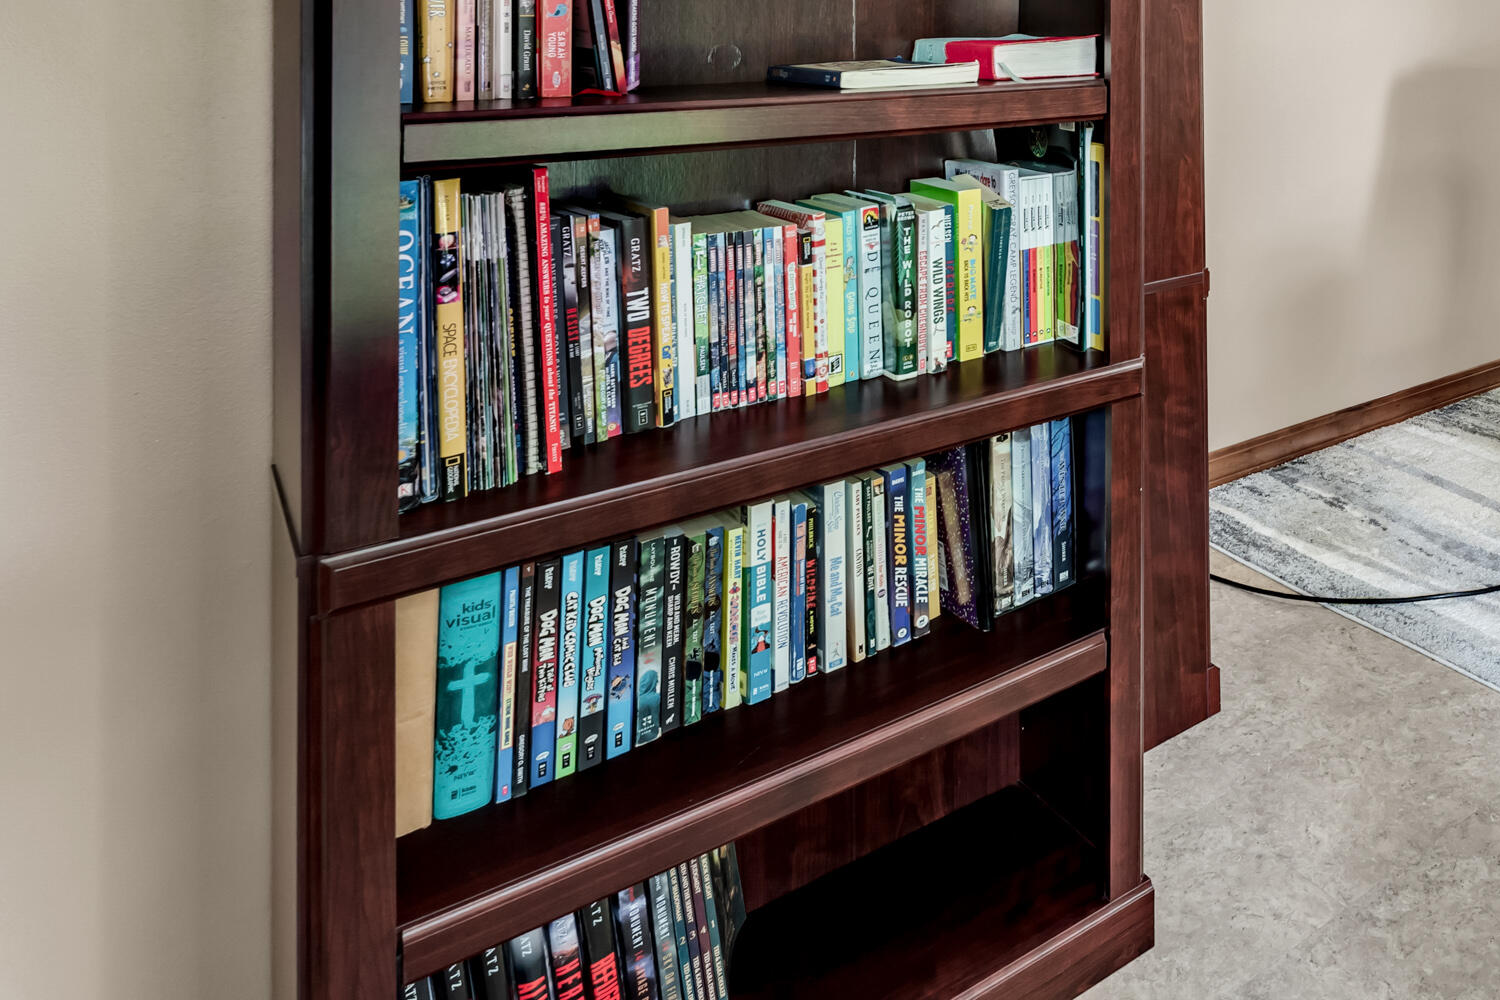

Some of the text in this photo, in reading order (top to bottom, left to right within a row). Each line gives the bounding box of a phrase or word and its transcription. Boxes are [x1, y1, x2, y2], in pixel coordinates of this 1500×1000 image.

[522, 29, 531, 71] David Grant
[548, 32, 557, 58] YOUNG
[557, 31, 566, 59] SARAH
[539, 222, 550, 257] AMAZING
[562, 226, 572, 257] GRATZ
[631, 237, 642, 274] GRATZ
[399, 229, 416, 336] OCEAN
[541, 258, 552, 295] ANSWERS
[901, 226, 913, 348] THE WILD ROBOT
[932, 257, 945, 324] WILD WINGS
[969, 258, 977, 299] BIG NATE
[1009, 269, 1018, 302] LEGEND
[696, 274, 707, 325] HATCHET
[918, 250, 928, 354] ESCAPE FROM CHERNOBYL
[543, 322, 554, 366] QUESTIONS
[567, 308, 579, 341] RESIST
[626, 287, 653, 389] TWO DEGREES
[866, 287, 882, 362] QUEEN
[442, 322, 458, 442] SPACE ENCYCLOPEDIA
[546, 367, 555, 386] about
[547, 388, 557, 400] the
[548, 401, 558, 433] TITANIC
[669, 546, 681, 585] ROWDY
[733, 534, 742, 579] KEVIN HART
[755, 528, 767, 603] HOLY BIBLE
[893, 495, 908, 608] THE MINOR RESCUE
[913, 487, 928, 603] THE MINOR MIRACLE
[565, 591, 579, 612] CAT
[673, 593, 681, 607] WILD
[776, 556, 789, 649] AMERICAN REVOLUTION
[806, 558, 816, 609] WILDFIRE
[827, 556, 842, 617] Me and My Cat
[445, 609, 496, 628] visual
[523, 598, 531, 626] TREASURE
[586, 595, 607, 647] DOG MAN
[612, 585, 632, 637] DOG MAN
[642, 587, 658, 649] MONUMENT
[666, 594, 675, 648] SHARP AND KEEN
[673, 608, 681, 621] AND
[536, 608, 559, 662] DOG MAN
[562, 662, 577, 689] CLUB
[666, 656, 676, 709] CHRIS MULLEN
[703, 881, 713, 899] LIGHT
[629, 904, 644, 949] MONUMENT
[655, 895, 676, 985] MONUMENT SKY ON
